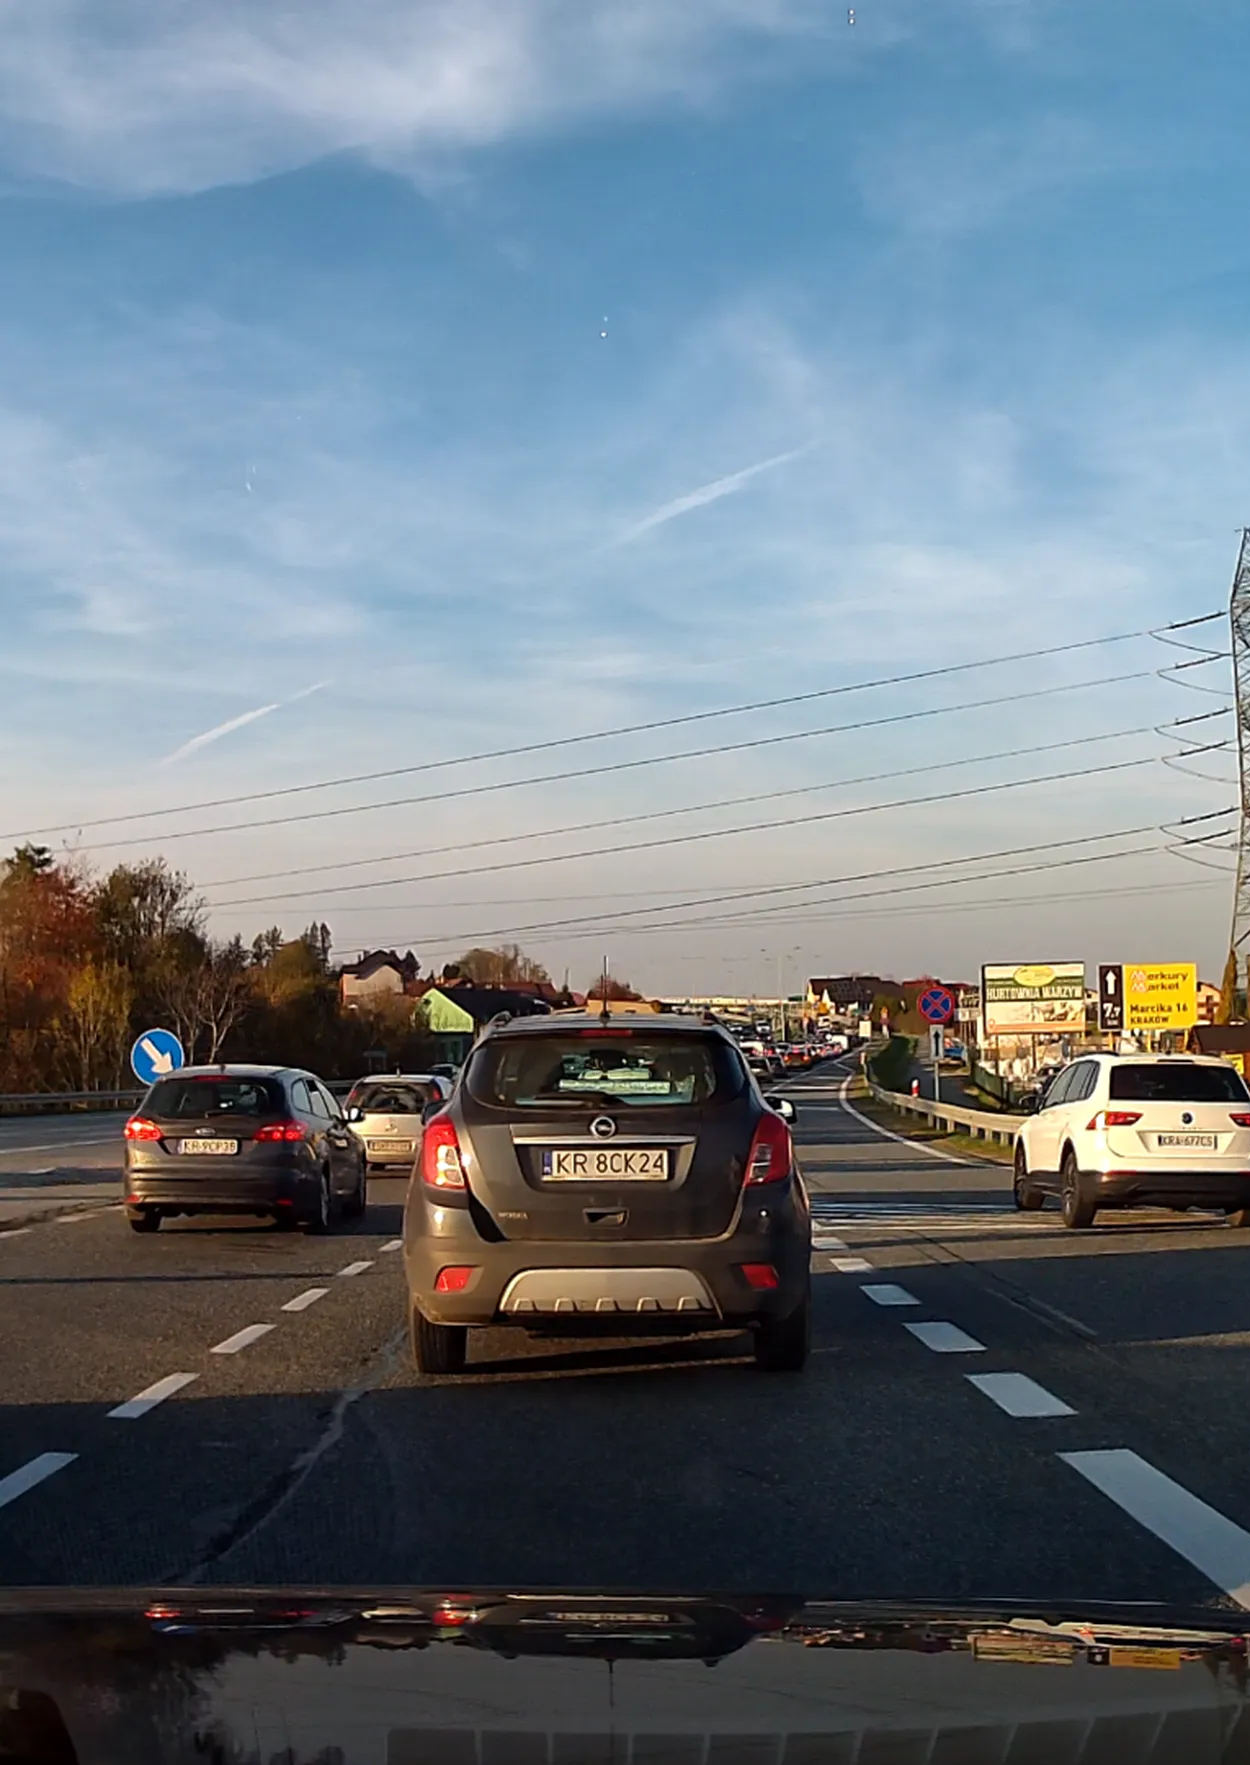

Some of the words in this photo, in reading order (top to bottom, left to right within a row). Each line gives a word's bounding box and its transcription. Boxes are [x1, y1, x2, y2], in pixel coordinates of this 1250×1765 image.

[987, 987, 1040, 1000] HURTOWNIA
[1130, 1004, 1172, 1014] Marcika
[1176, 1003, 1188, 1012] 16
[556, 1153, 588, 1174] KR
[595, 1153, 665, 1174] 8CK24
